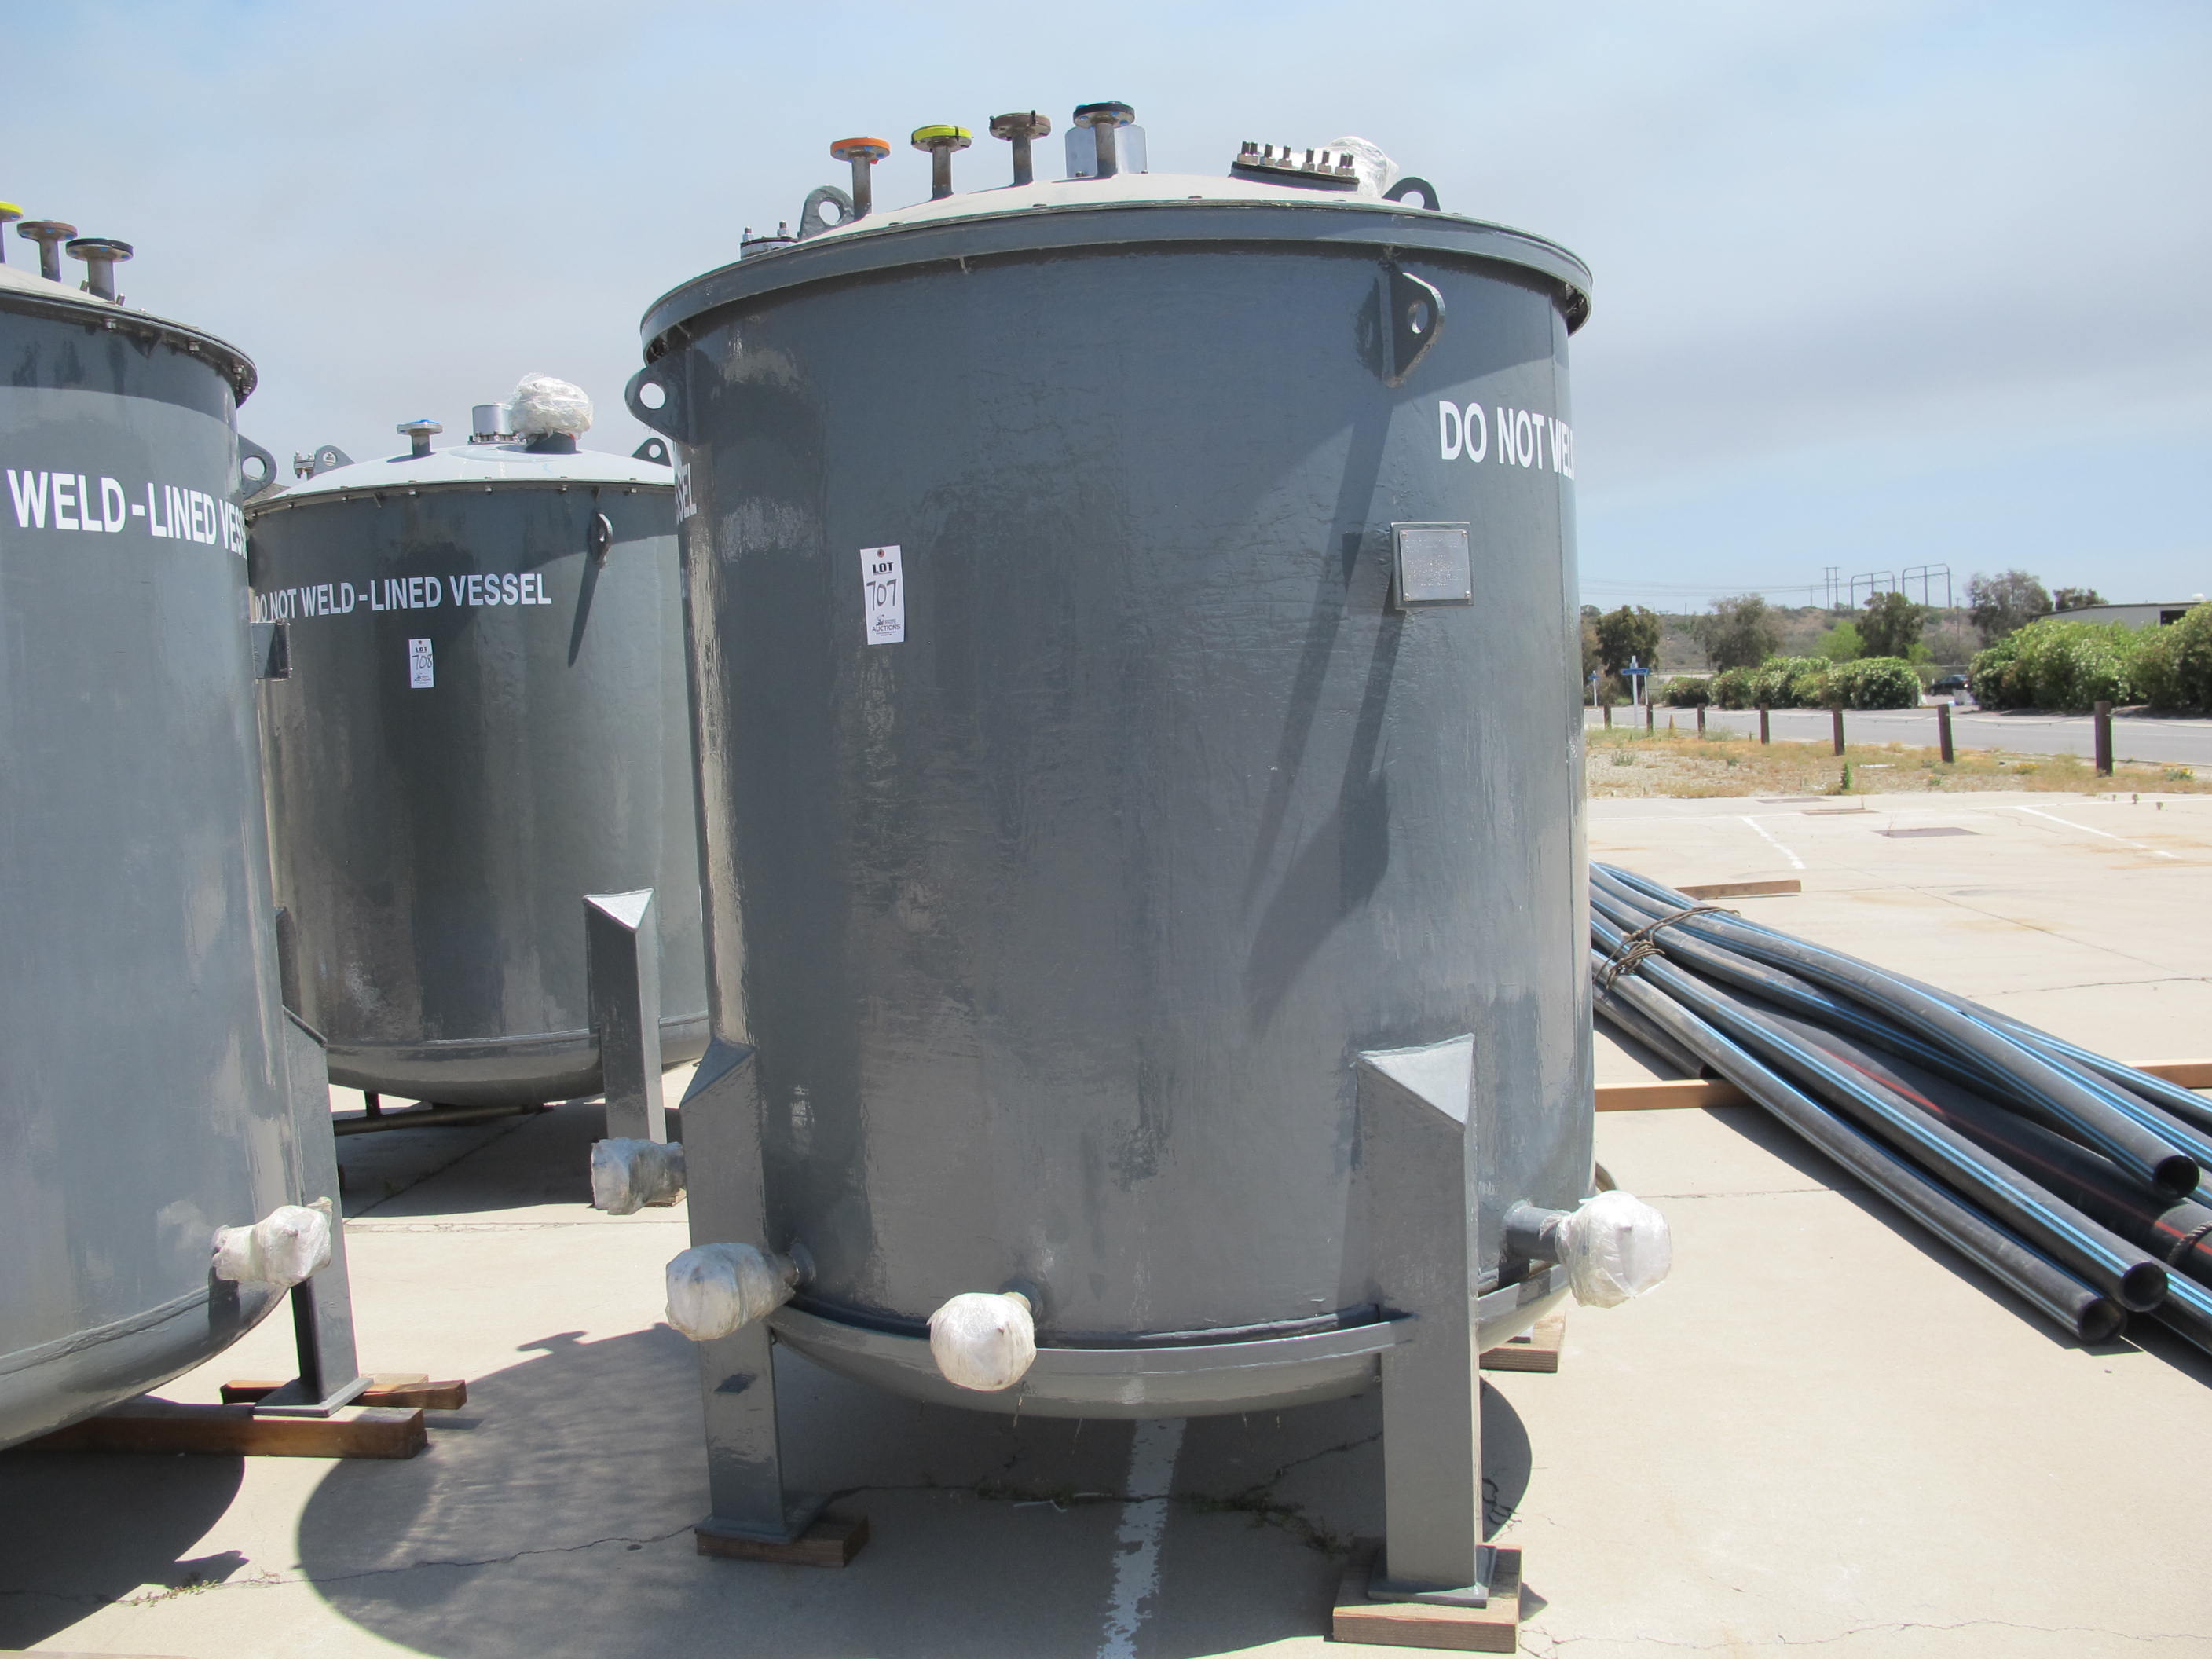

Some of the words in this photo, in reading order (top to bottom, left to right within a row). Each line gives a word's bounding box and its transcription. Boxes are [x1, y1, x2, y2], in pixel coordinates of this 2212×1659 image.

[1439, 400, 1487, 463] DO
[1496, 406, 1544, 470] NOT
[872, 562, 894, 573] LOT
[269, 588, 297, 621] NOT
[449, 573, 552, 606] VESSEL
[866, 578, 897, 611] 707
[412, 654, 433, 670] 708
